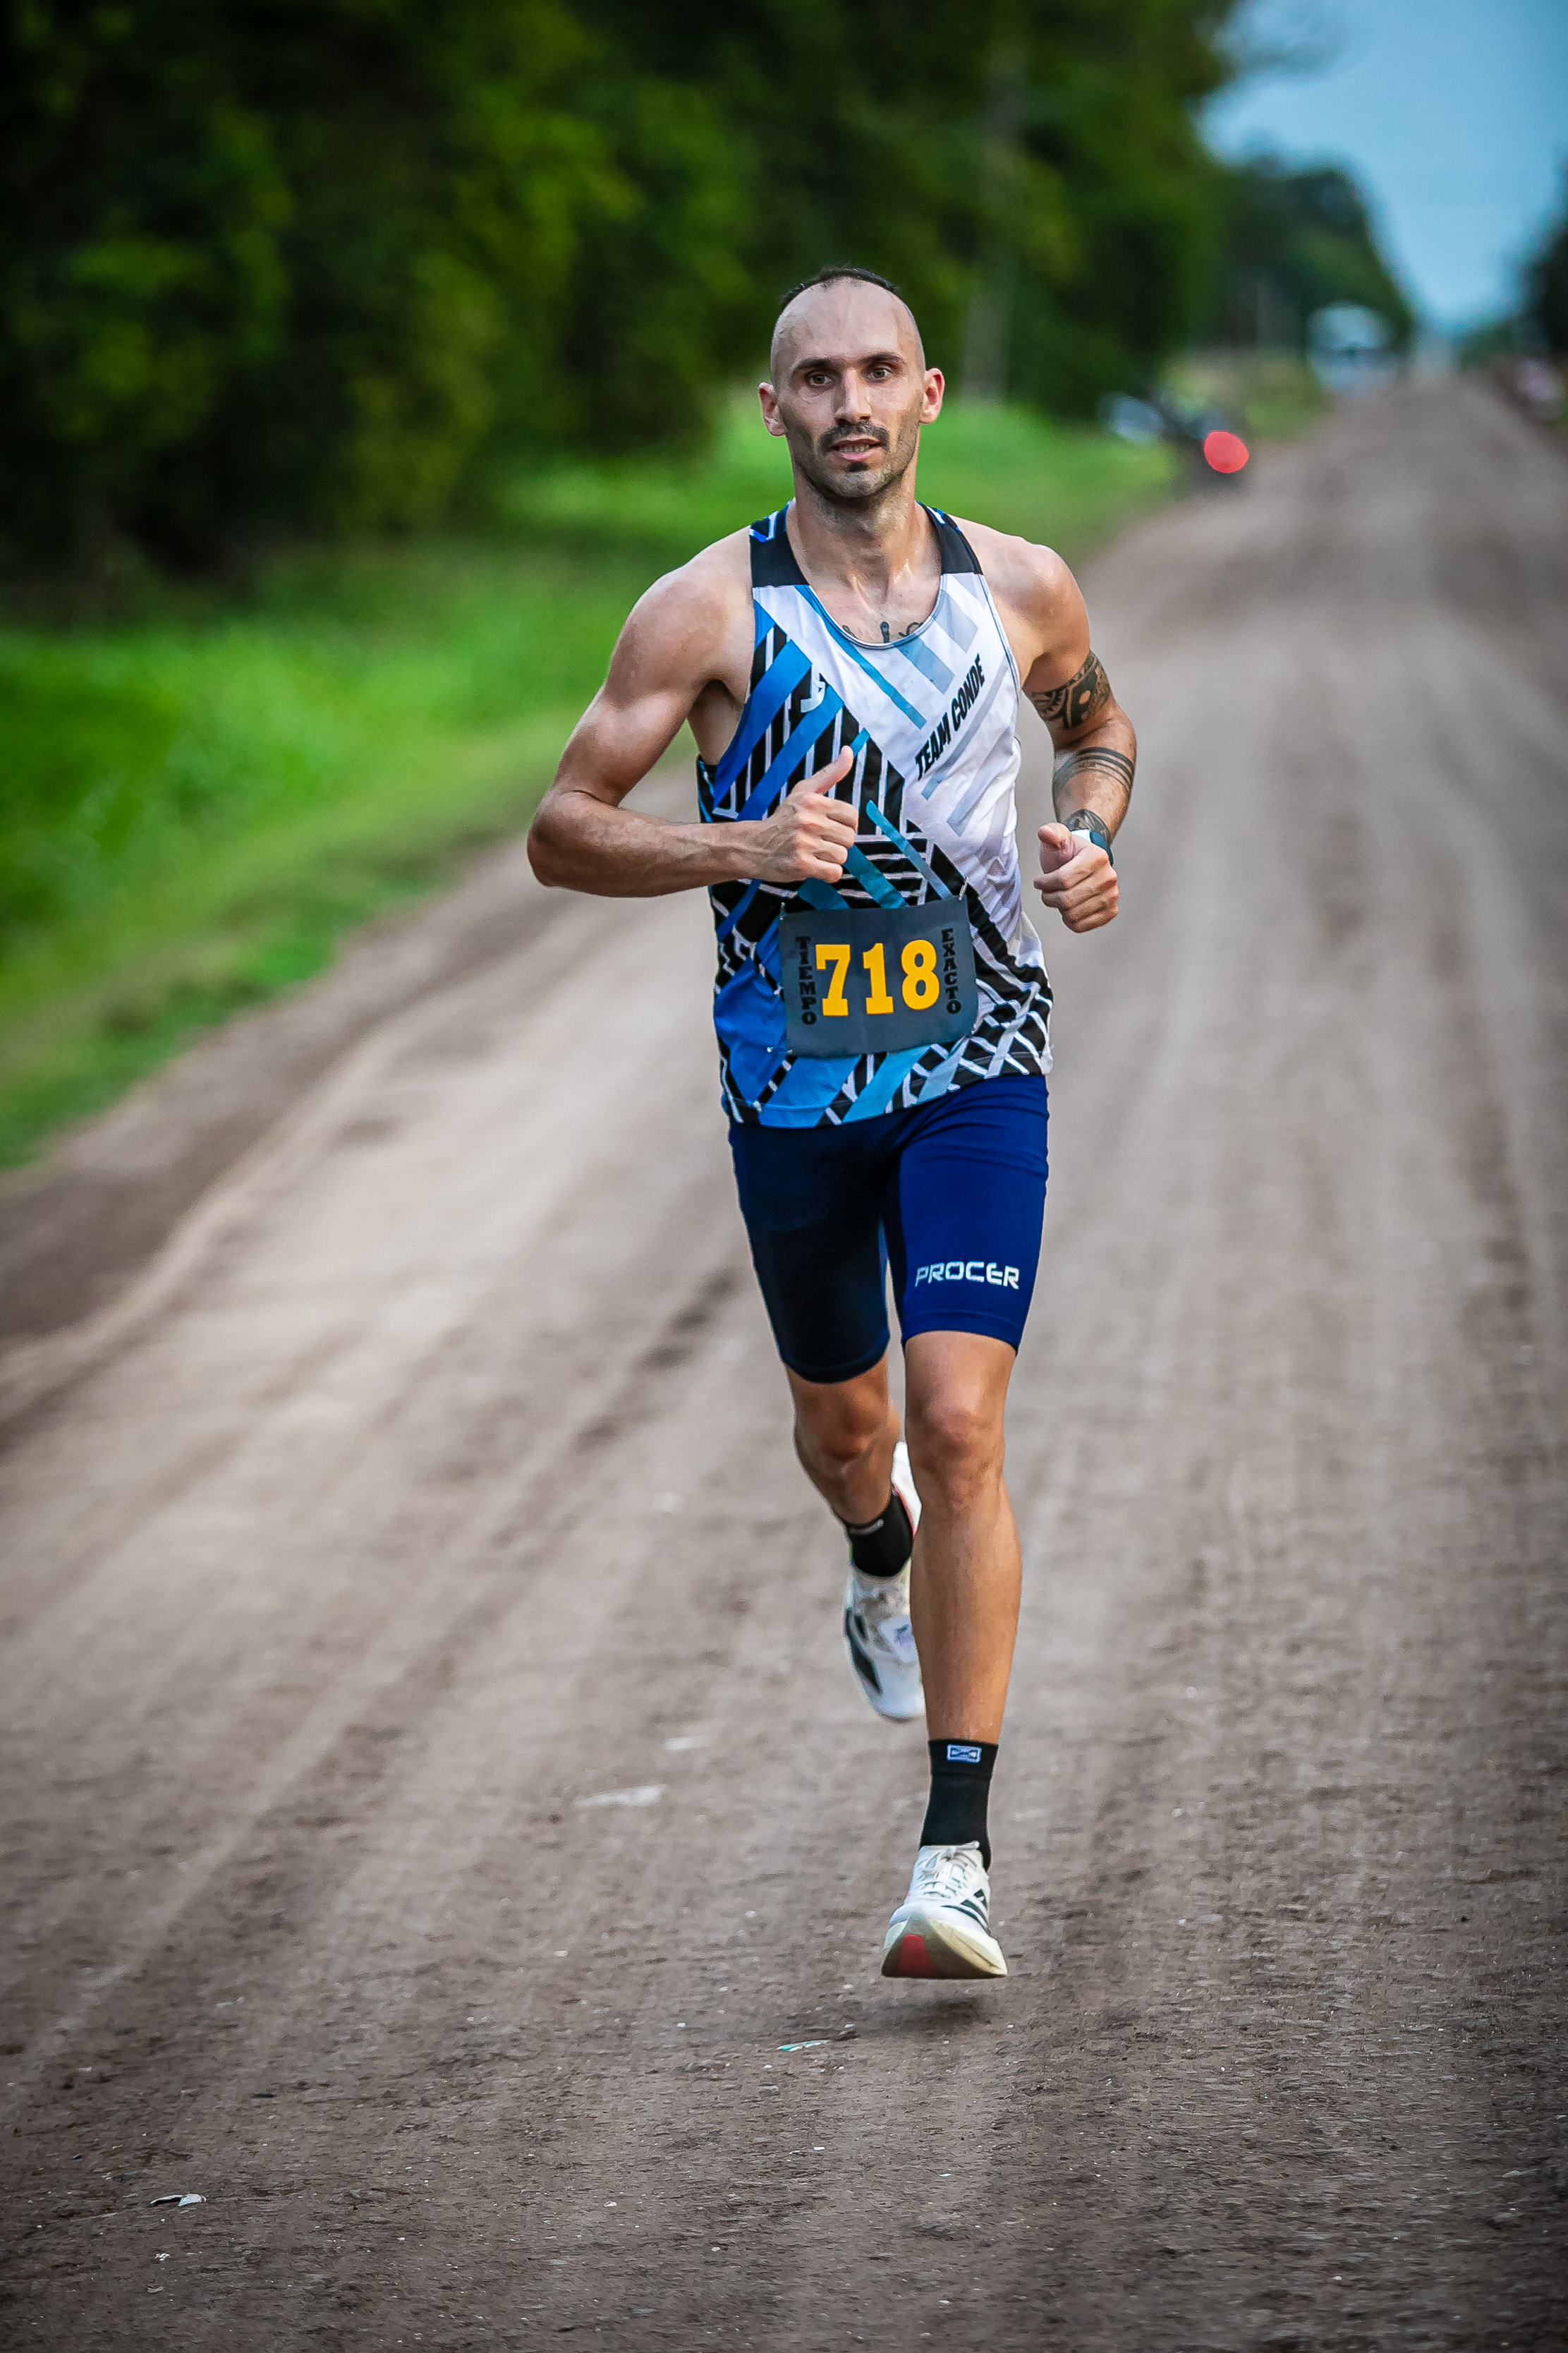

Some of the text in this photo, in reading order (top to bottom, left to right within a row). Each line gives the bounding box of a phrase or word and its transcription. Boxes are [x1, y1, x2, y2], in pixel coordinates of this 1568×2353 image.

[915, 653, 985, 780] TEAM CONDE
[796, 936, 818, 1025] TIEMPO
[815, 939, 940, 1017] 718
[941, 928, 962, 1015] EXACTO
[914, 1261, 1020, 1290] PROCER
